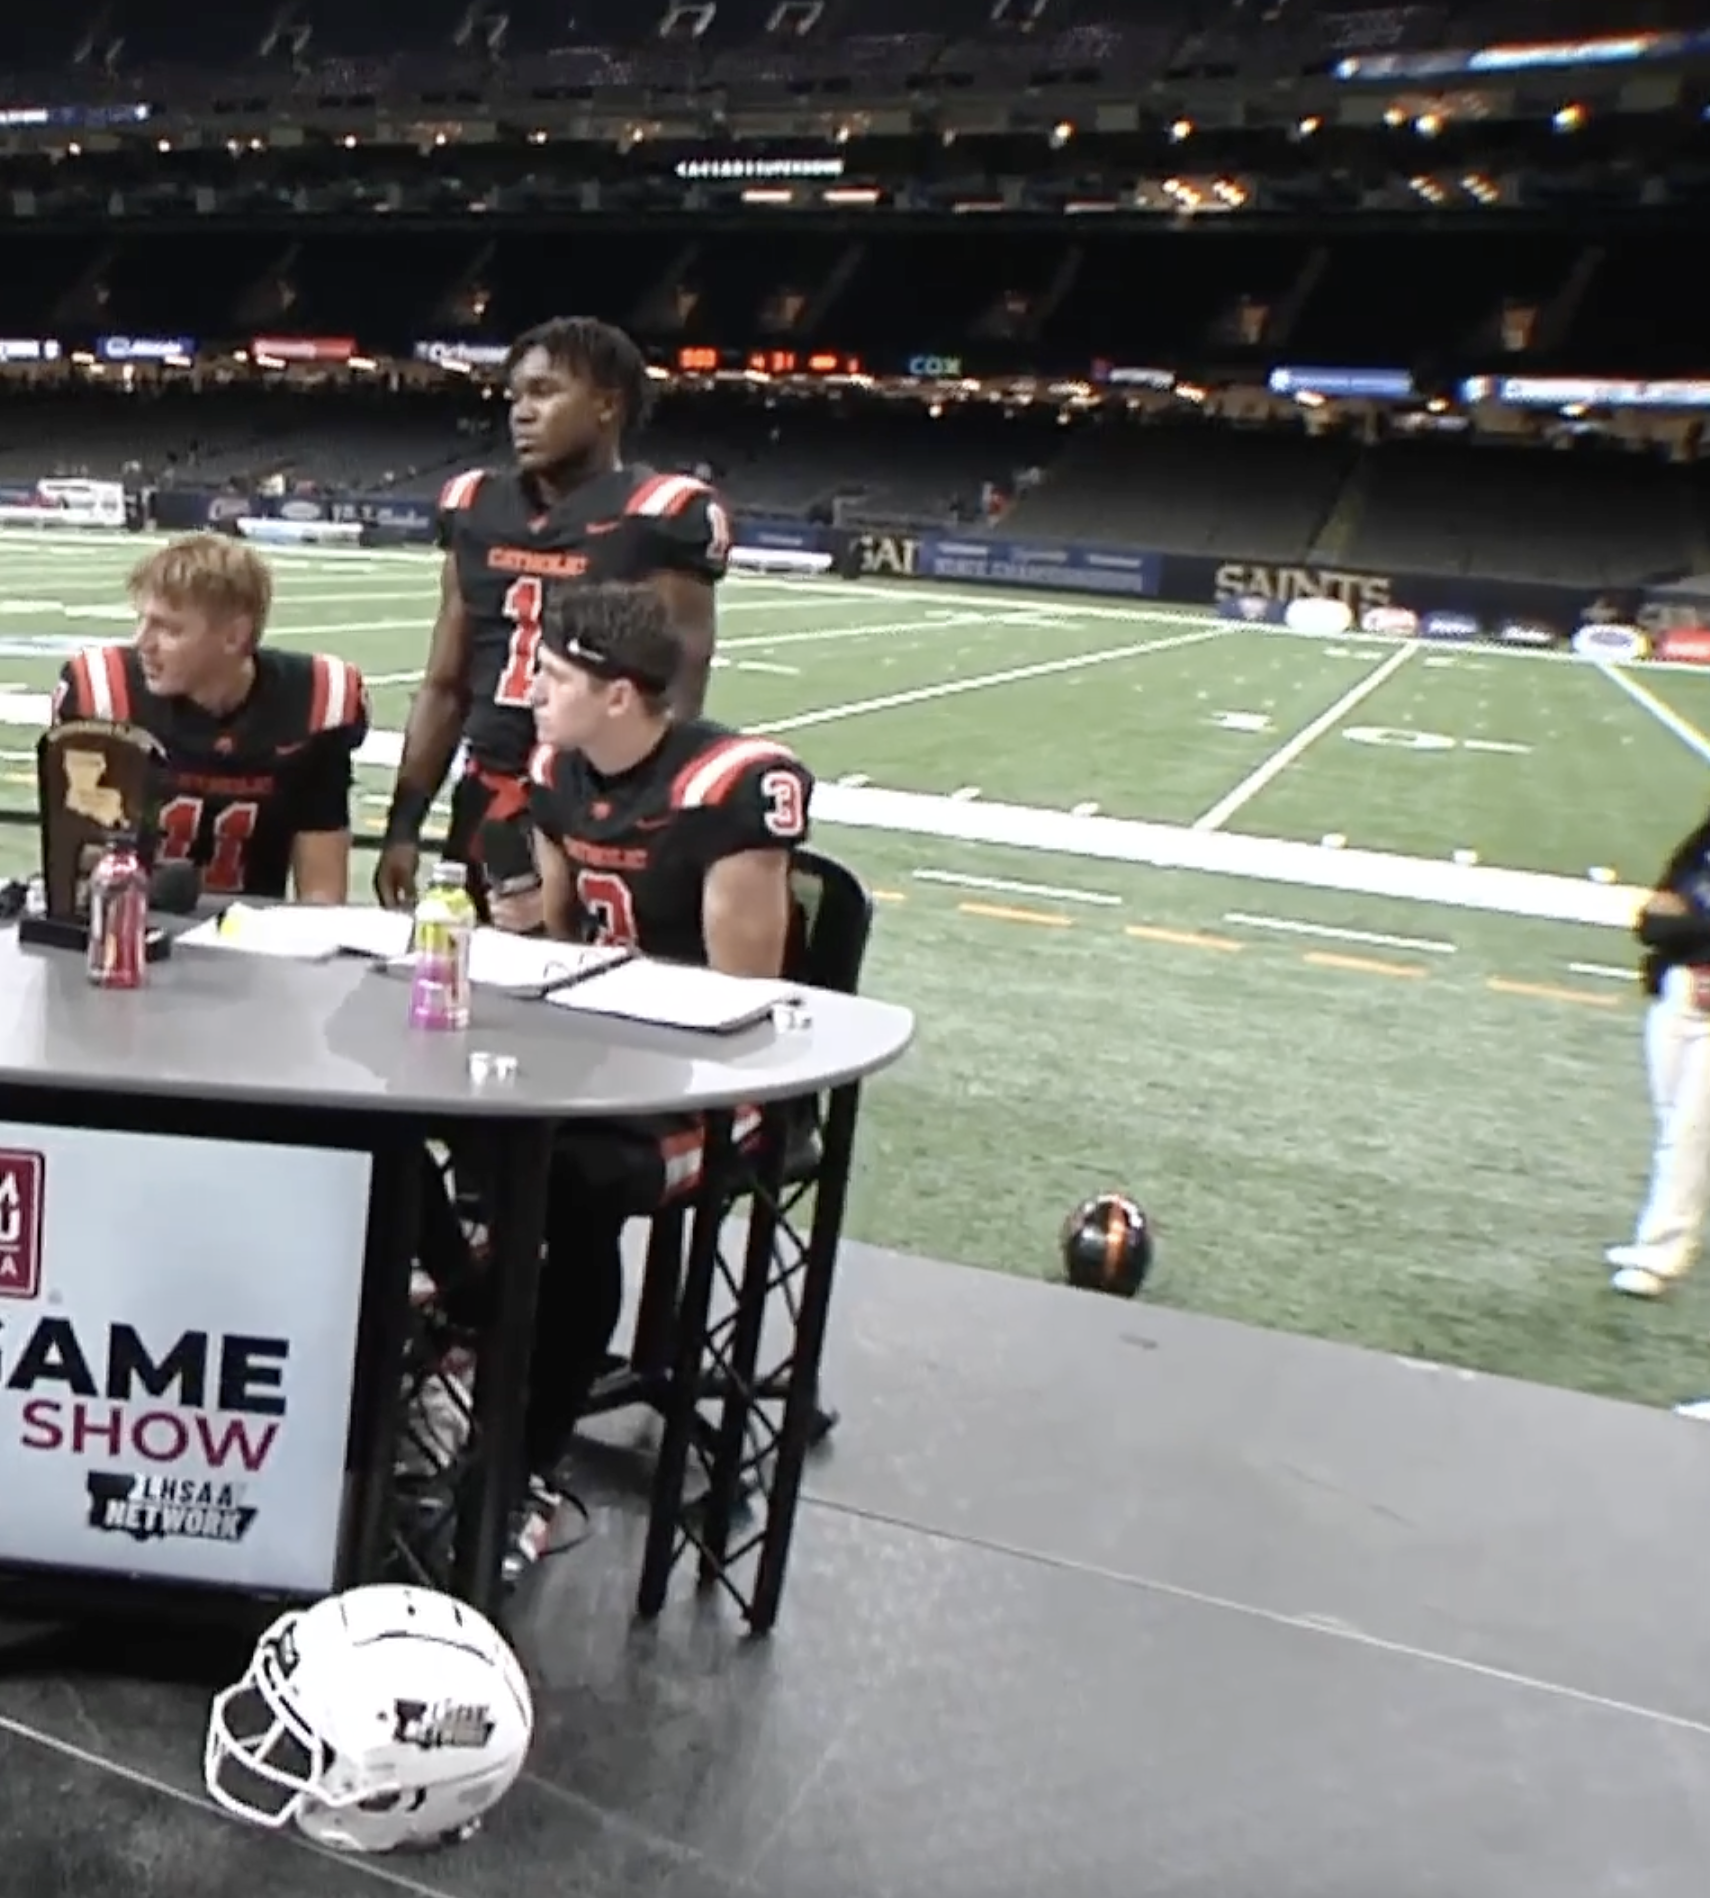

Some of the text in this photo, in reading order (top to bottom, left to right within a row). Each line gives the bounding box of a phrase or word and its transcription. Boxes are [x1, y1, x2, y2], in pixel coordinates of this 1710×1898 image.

[909, 355, 961, 375] COX
[493, 576, 543, 708] 1
[761, 770, 807, 837] 3
[153, 795, 258, 894] 11
[21, 1399, 281, 1472] SHOW
[104, 1498, 242, 1538] NETWORK
[142, 1477, 234, 1508] LHSAA
